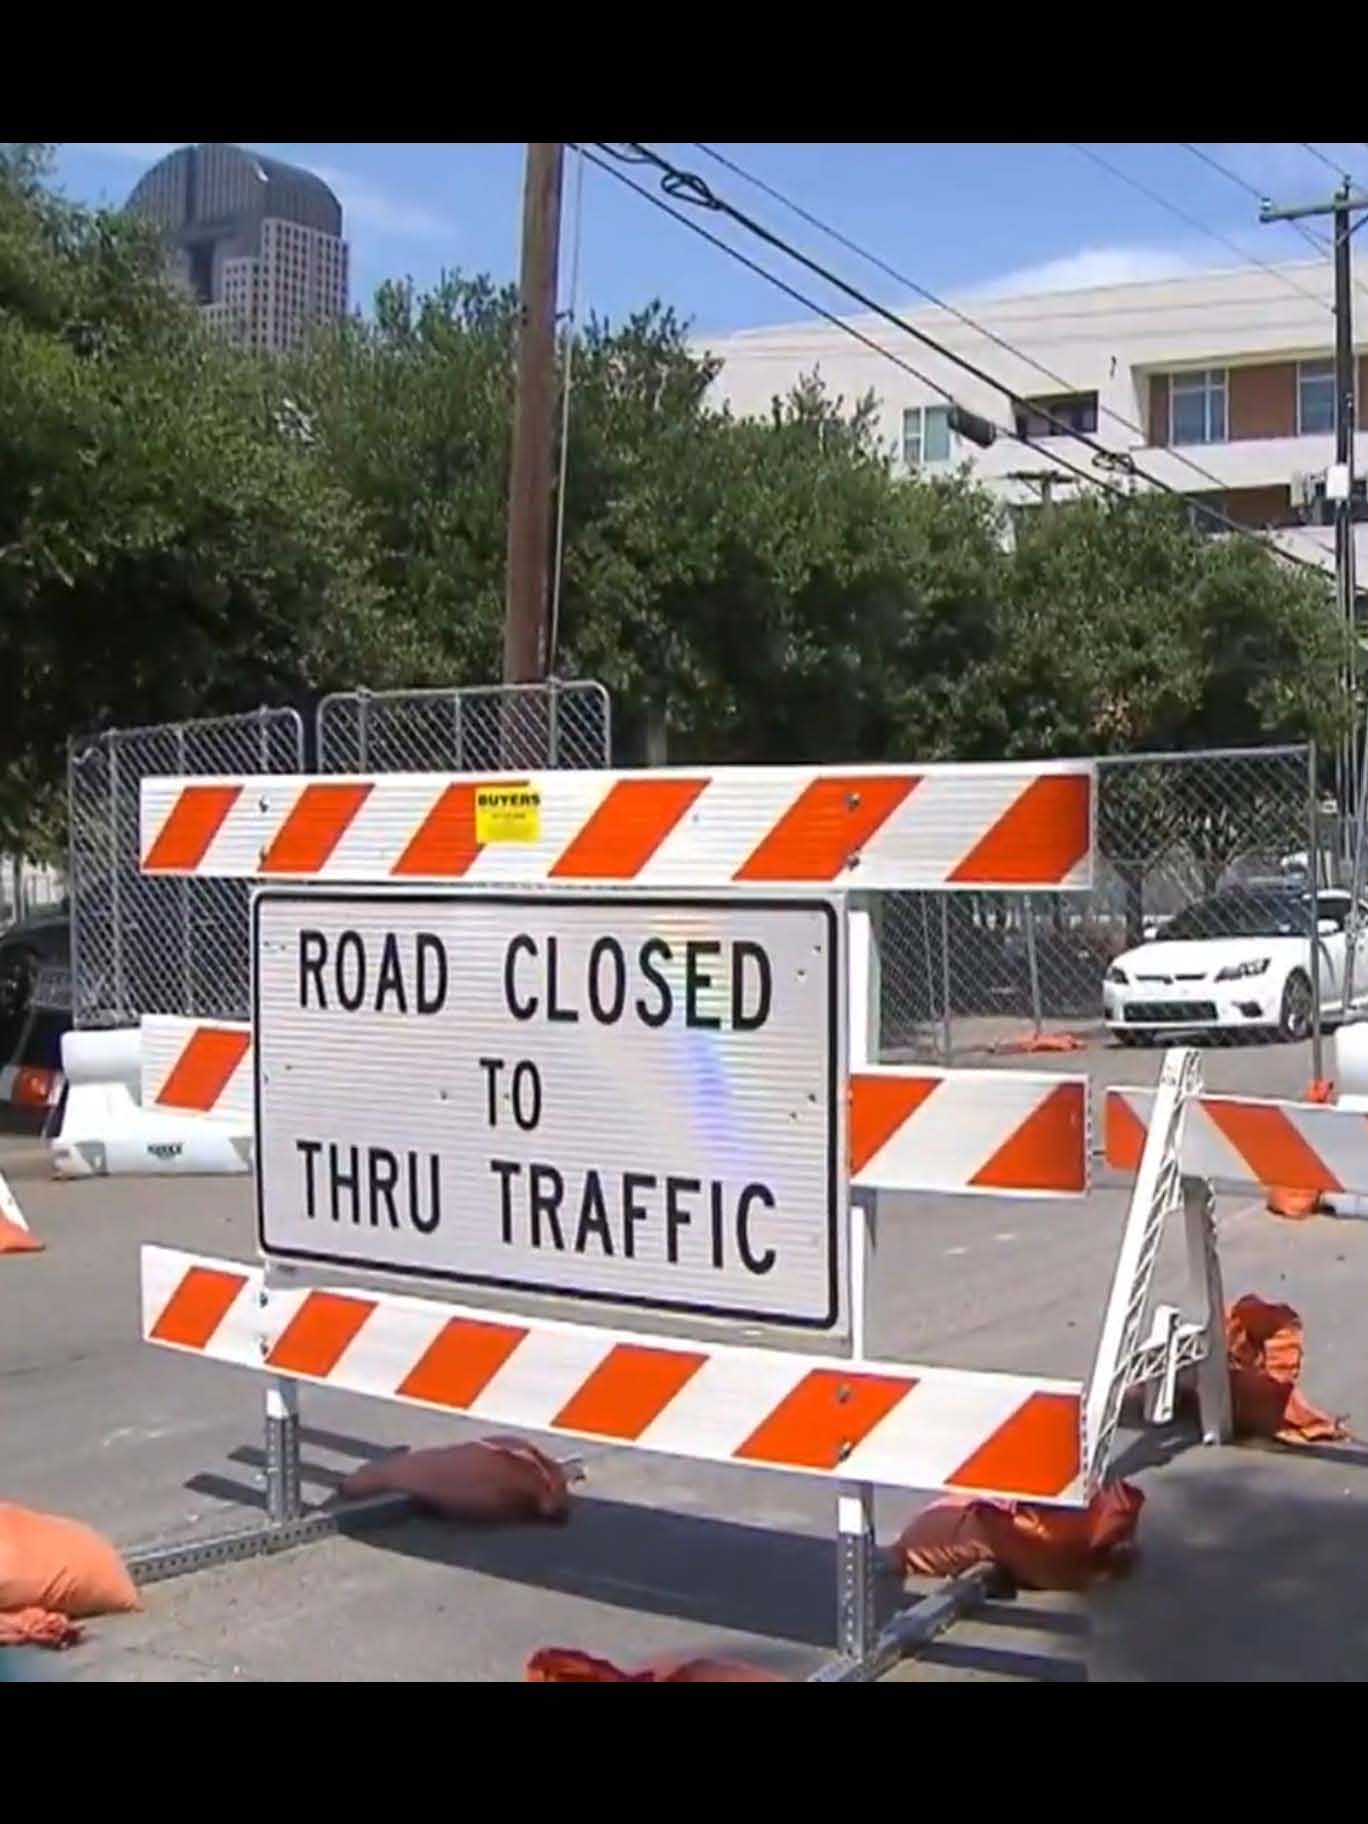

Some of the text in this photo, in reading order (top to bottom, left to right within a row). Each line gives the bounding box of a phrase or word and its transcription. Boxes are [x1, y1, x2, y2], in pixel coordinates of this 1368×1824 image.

[478, 792, 541, 808] BUYERS
[299, 930, 772, 1031] ROAD CLOSED
[479, 1057, 542, 1131] TO
[296, 1140, 776, 1275] THRU TRAFFIC
